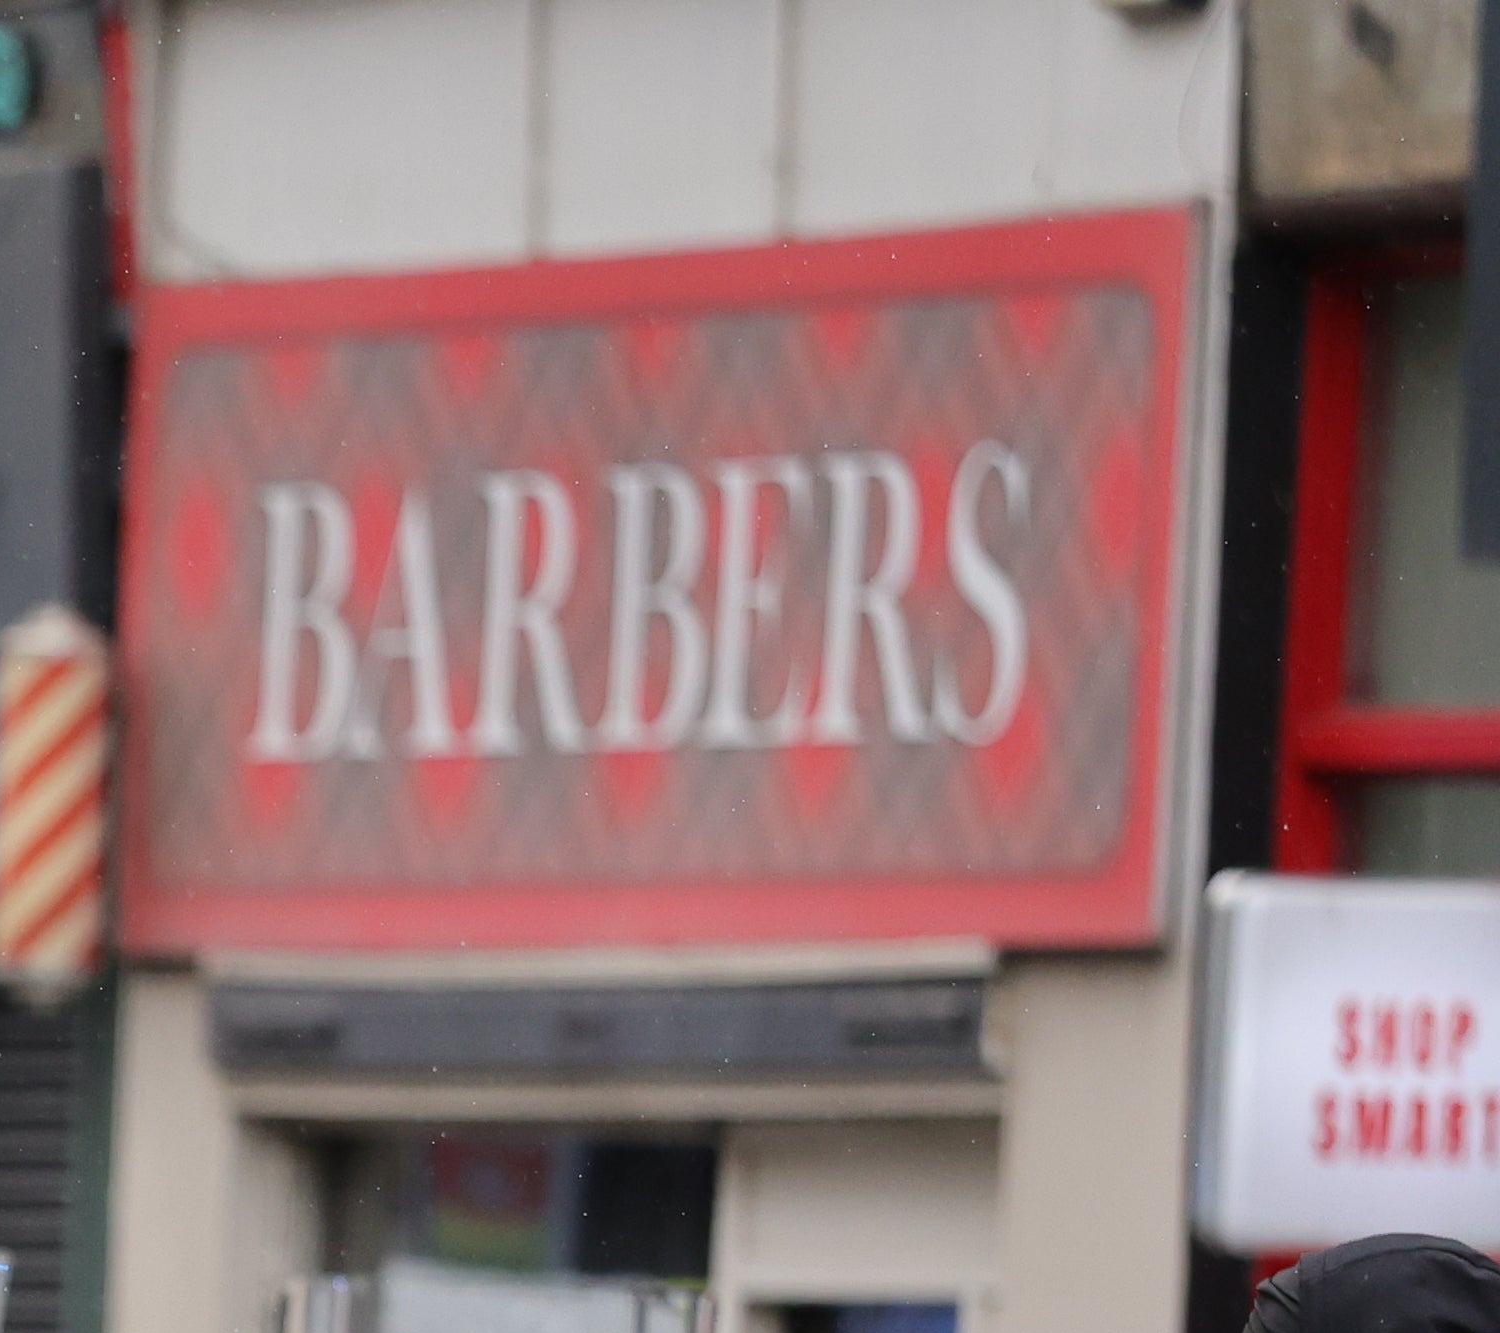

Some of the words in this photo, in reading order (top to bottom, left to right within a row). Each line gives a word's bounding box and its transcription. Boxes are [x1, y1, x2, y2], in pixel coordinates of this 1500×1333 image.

[250, 440, 1030, 762] BARBERS
[1336, 995, 1475, 1073] SHOP
[1316, 1084, 1500, 1163] SMART
